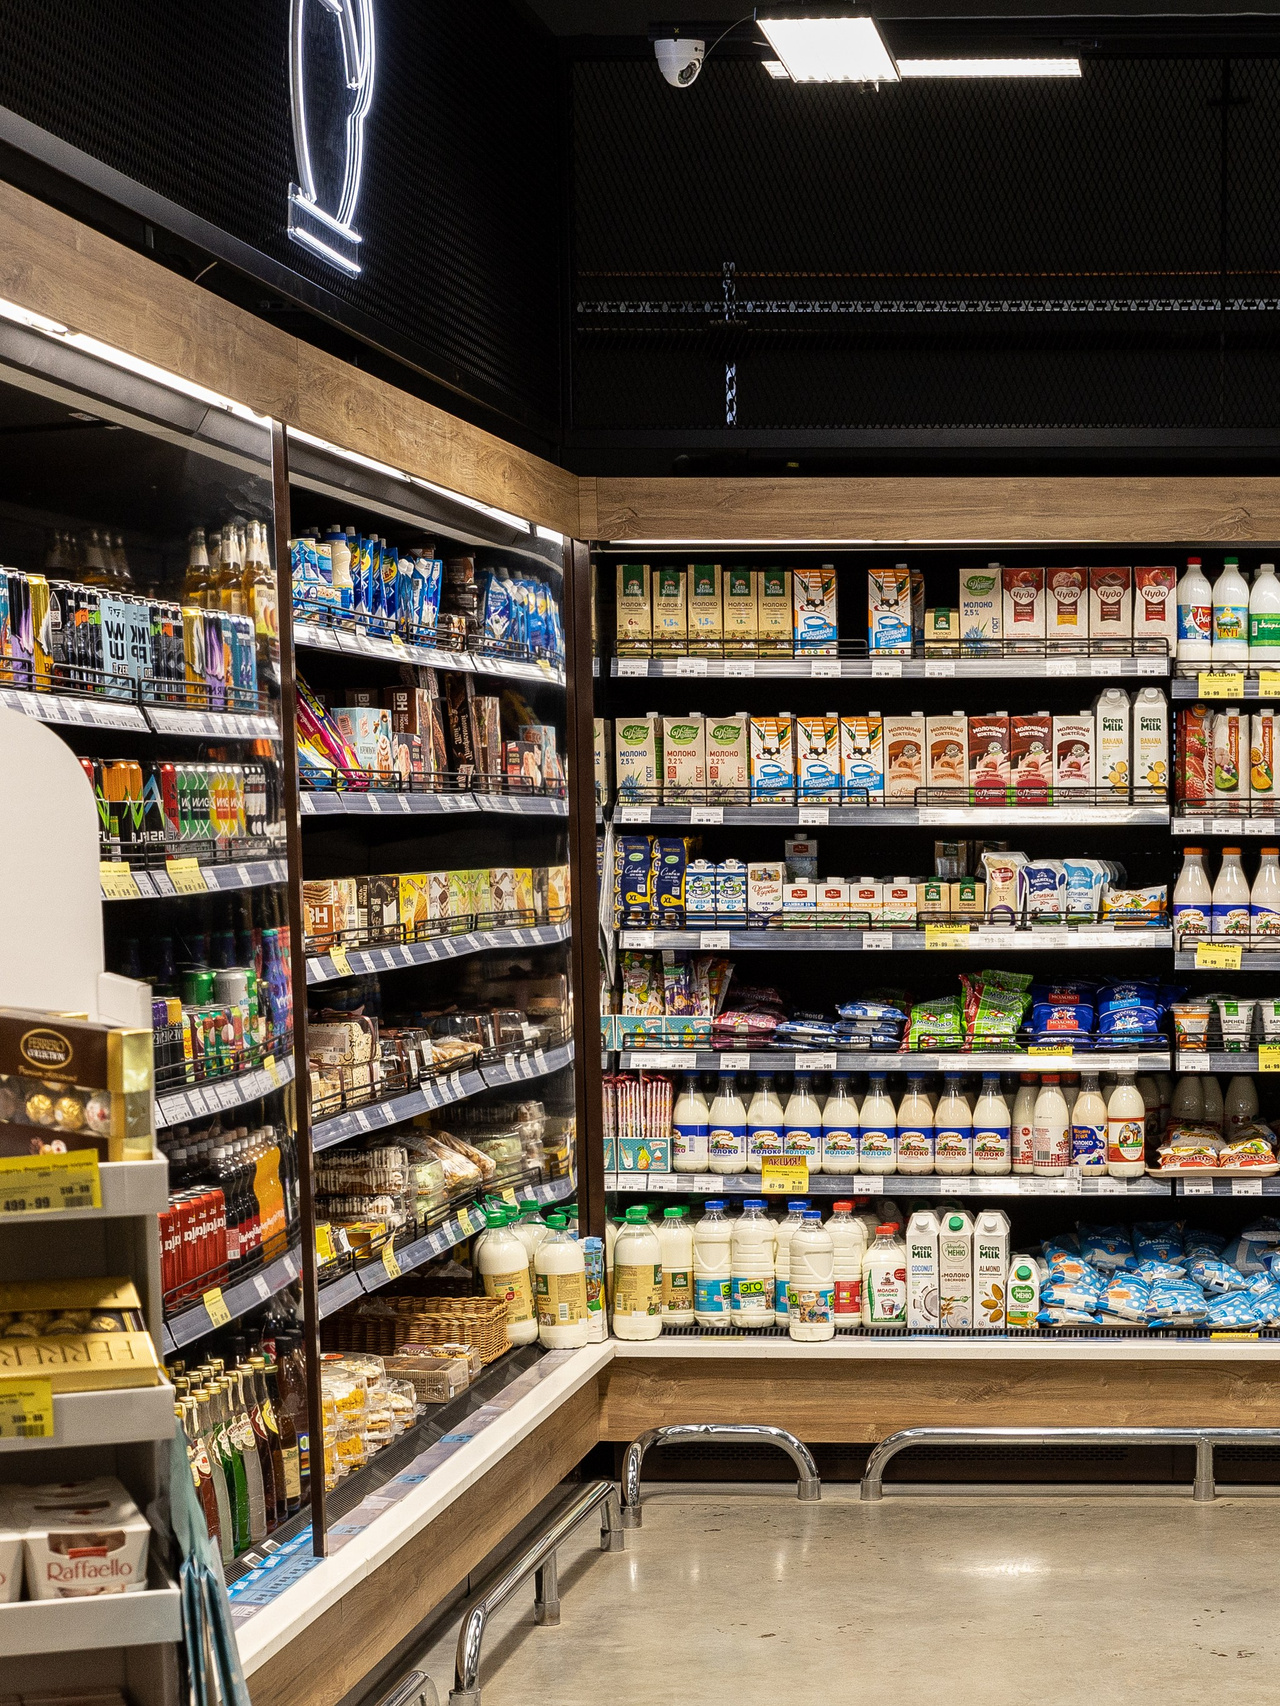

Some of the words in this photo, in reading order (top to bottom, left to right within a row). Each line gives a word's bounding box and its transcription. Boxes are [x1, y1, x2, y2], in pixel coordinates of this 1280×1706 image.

[1103, 723, 1123, 732] Milk
[1141, 723, 1161, 732] Milk
[912, 1250, 932, 1259] Milk
[980, 1250, 1000, 1259] Milk
[47, 1559, 132, 1582] Raffaello
